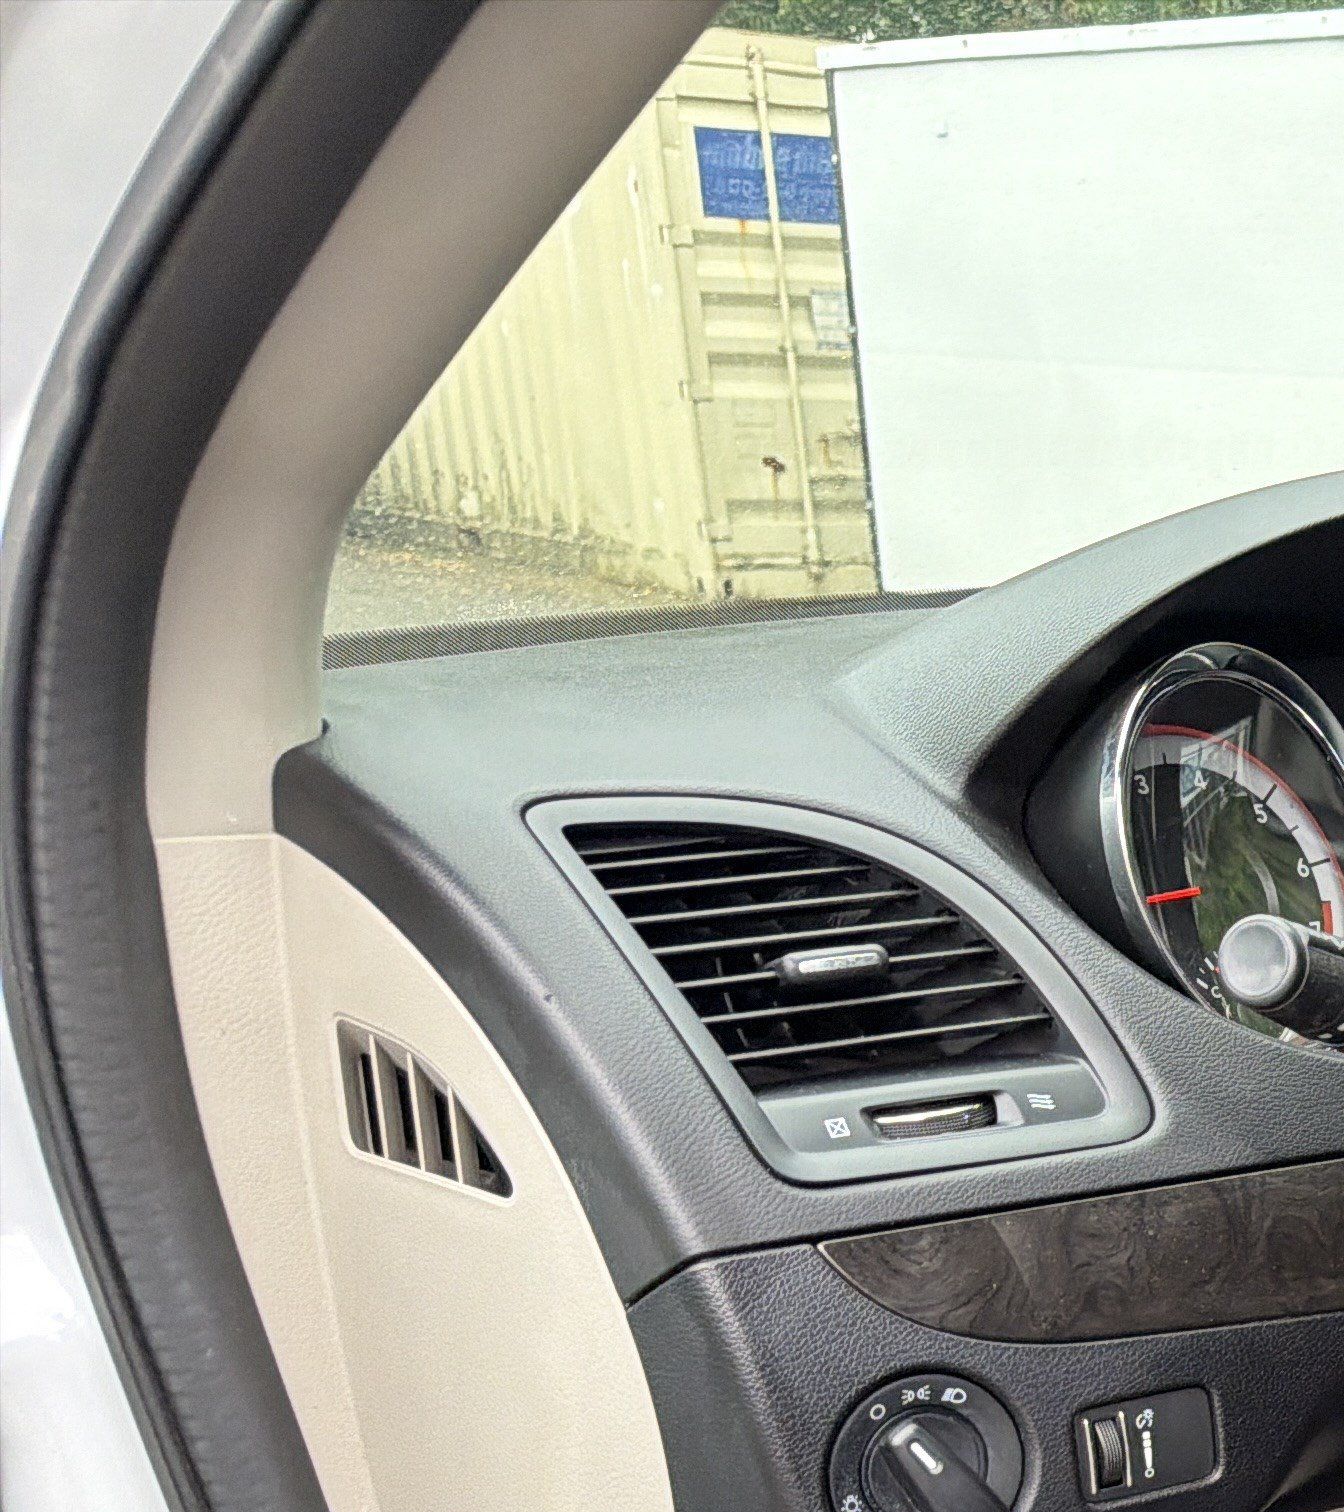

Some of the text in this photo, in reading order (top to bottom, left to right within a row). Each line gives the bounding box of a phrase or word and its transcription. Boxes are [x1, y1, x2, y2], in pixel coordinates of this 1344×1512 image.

[1134, 775, 1149, 795] 3
[1194, 770, 1208, 790] 4
[1253, 803, 1268, 824] 5
[1297, 858, 1310, 878] 6
[1211, 986, 1222, 998] C
